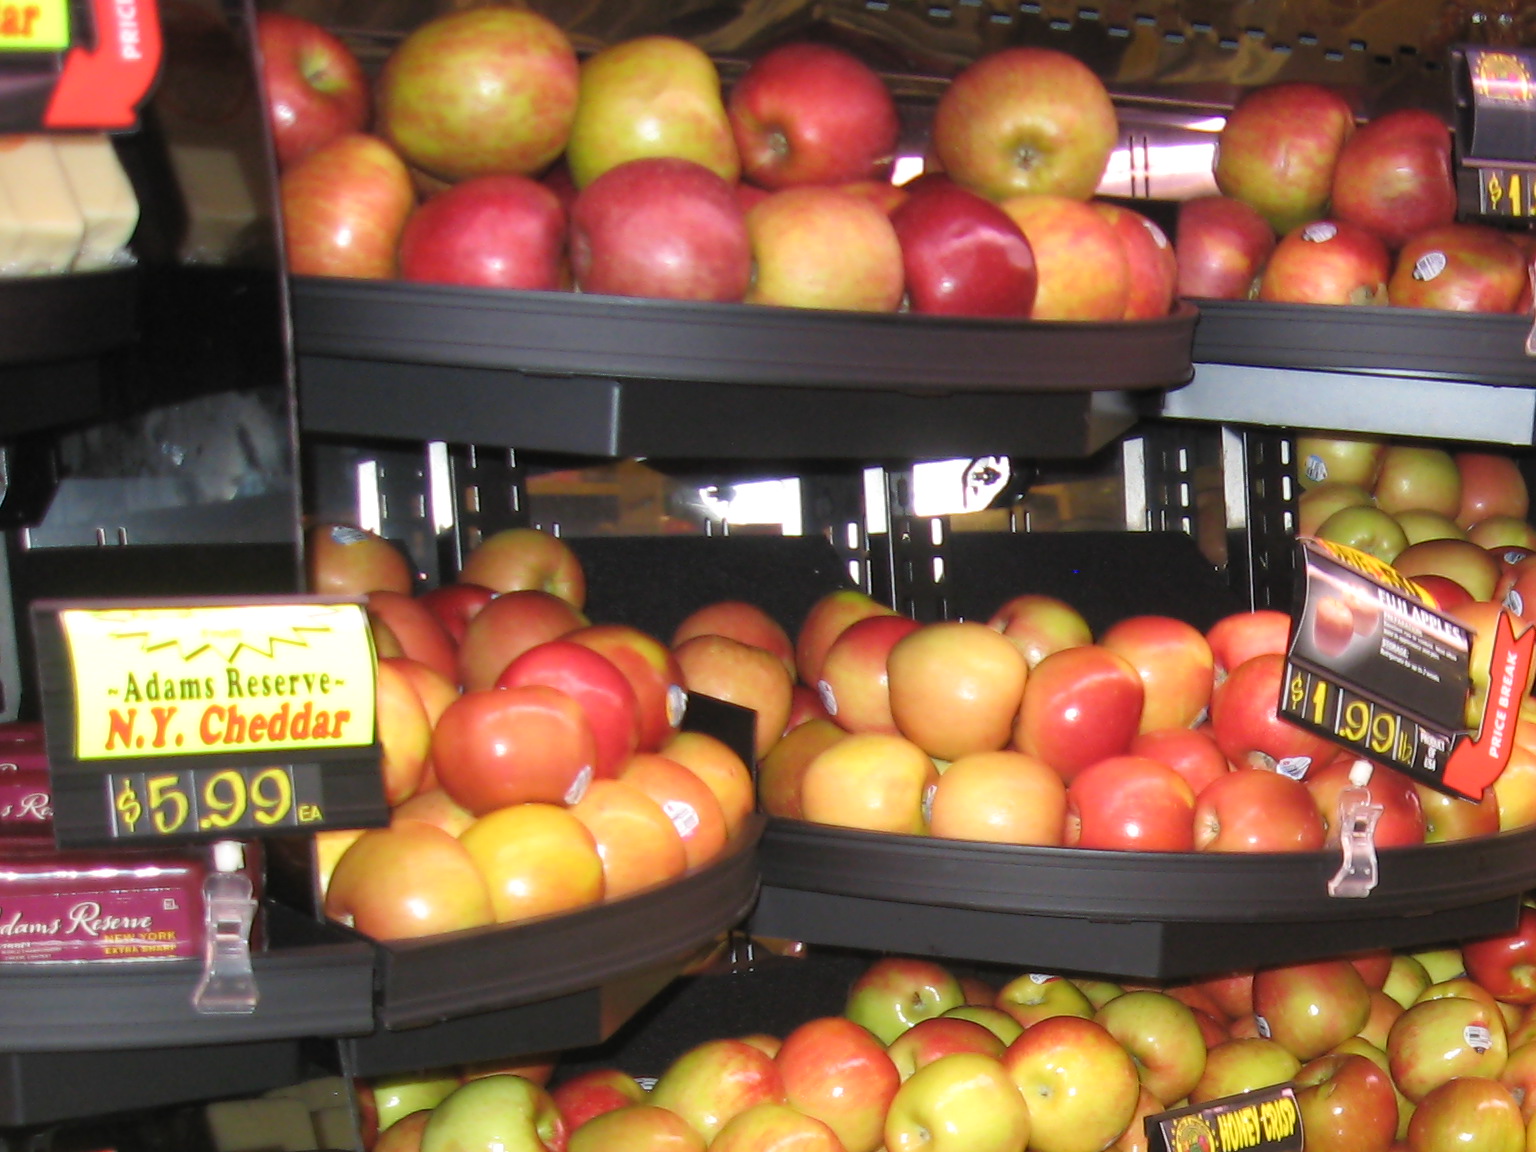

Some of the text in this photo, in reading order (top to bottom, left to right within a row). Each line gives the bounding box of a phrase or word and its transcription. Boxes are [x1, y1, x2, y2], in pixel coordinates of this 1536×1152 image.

[1411, 605, 1462, 645] APPLES
[105, 701, 350, 751] N.Y. Cheddar
[1291, 671, 1396, 754] $1.99
[1489, 650, 1518, 759] PRICE BREAK
[117, 768, 324, 834] $5.99 EA
[0, 901, 152, 937] dams Reserve
